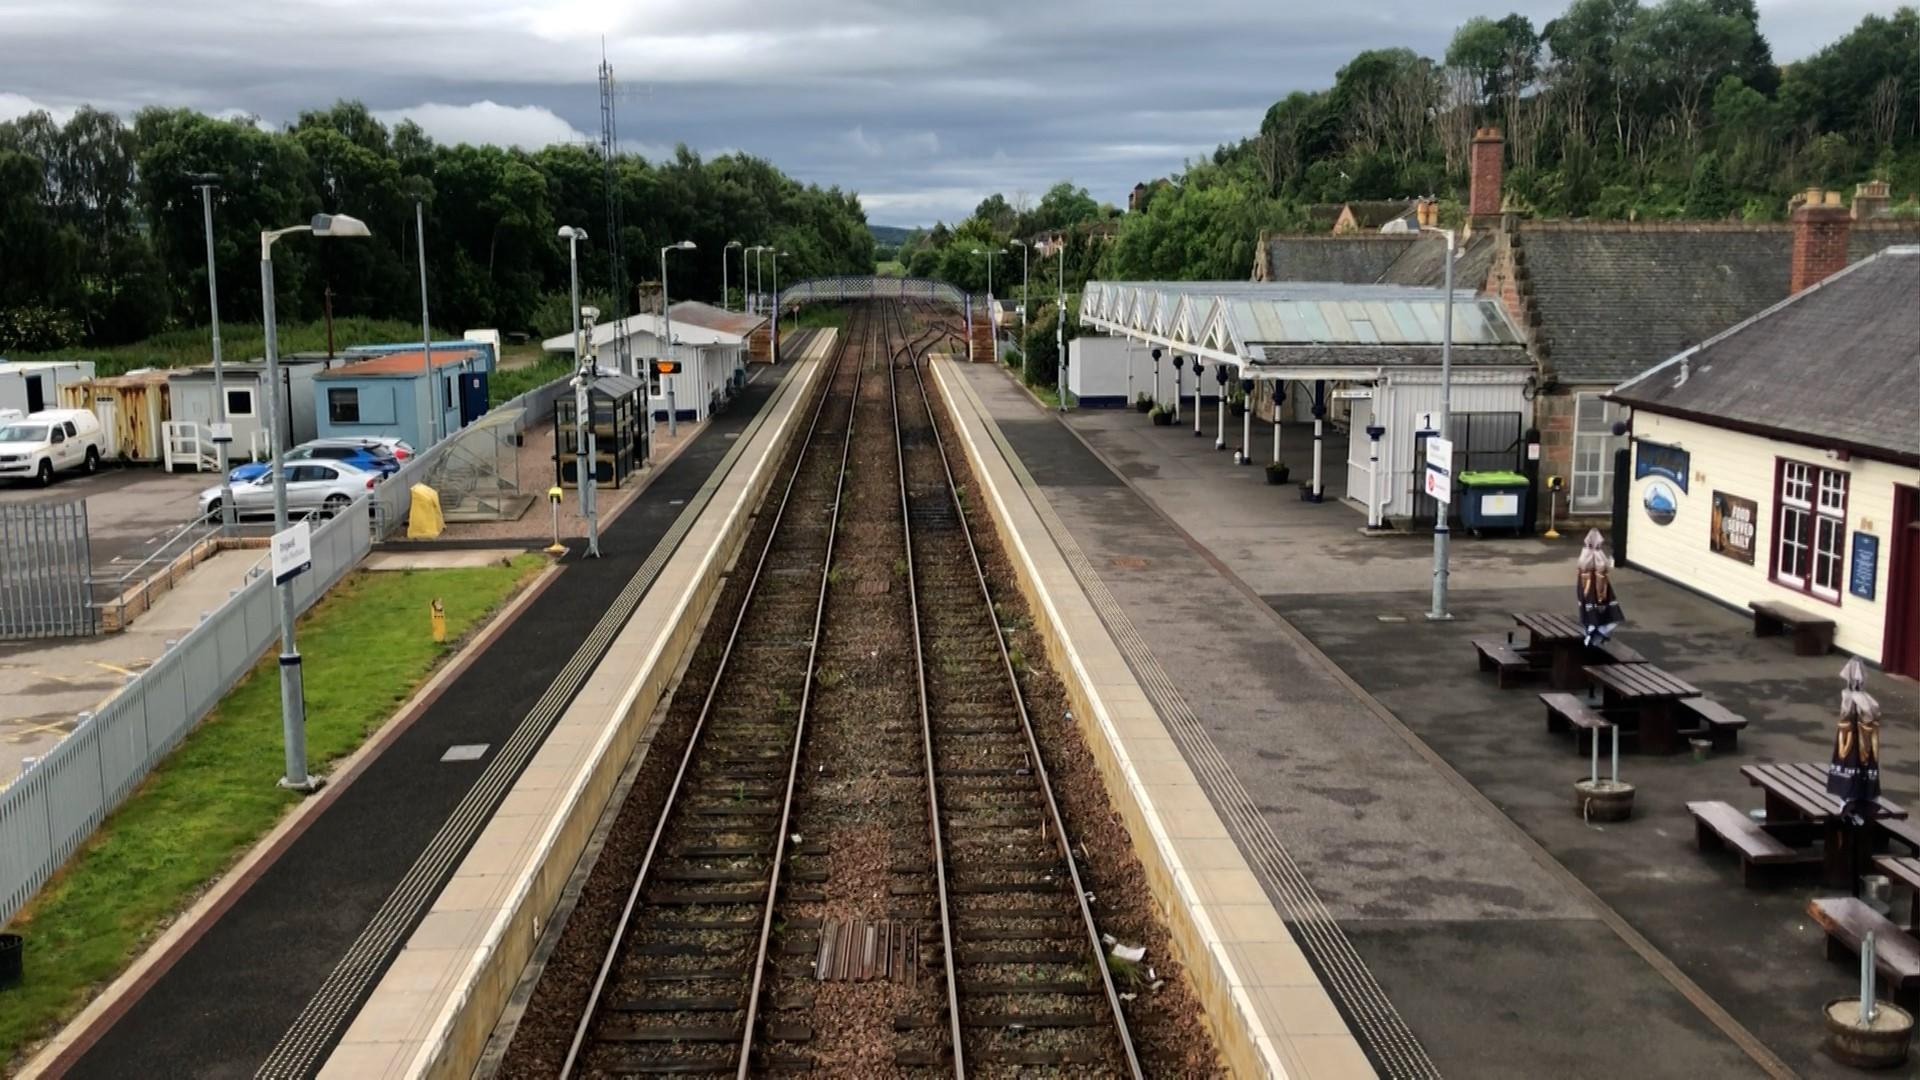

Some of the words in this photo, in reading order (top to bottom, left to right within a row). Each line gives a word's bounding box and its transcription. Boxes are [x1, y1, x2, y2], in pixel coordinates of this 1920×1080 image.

[1424, 413, 1432, 429] 1
[1731, 505, 1750, 521] FOOD
[1727, 518, 1754, 537] SERVED
[1730, 533, 1750, 550] DAILY
